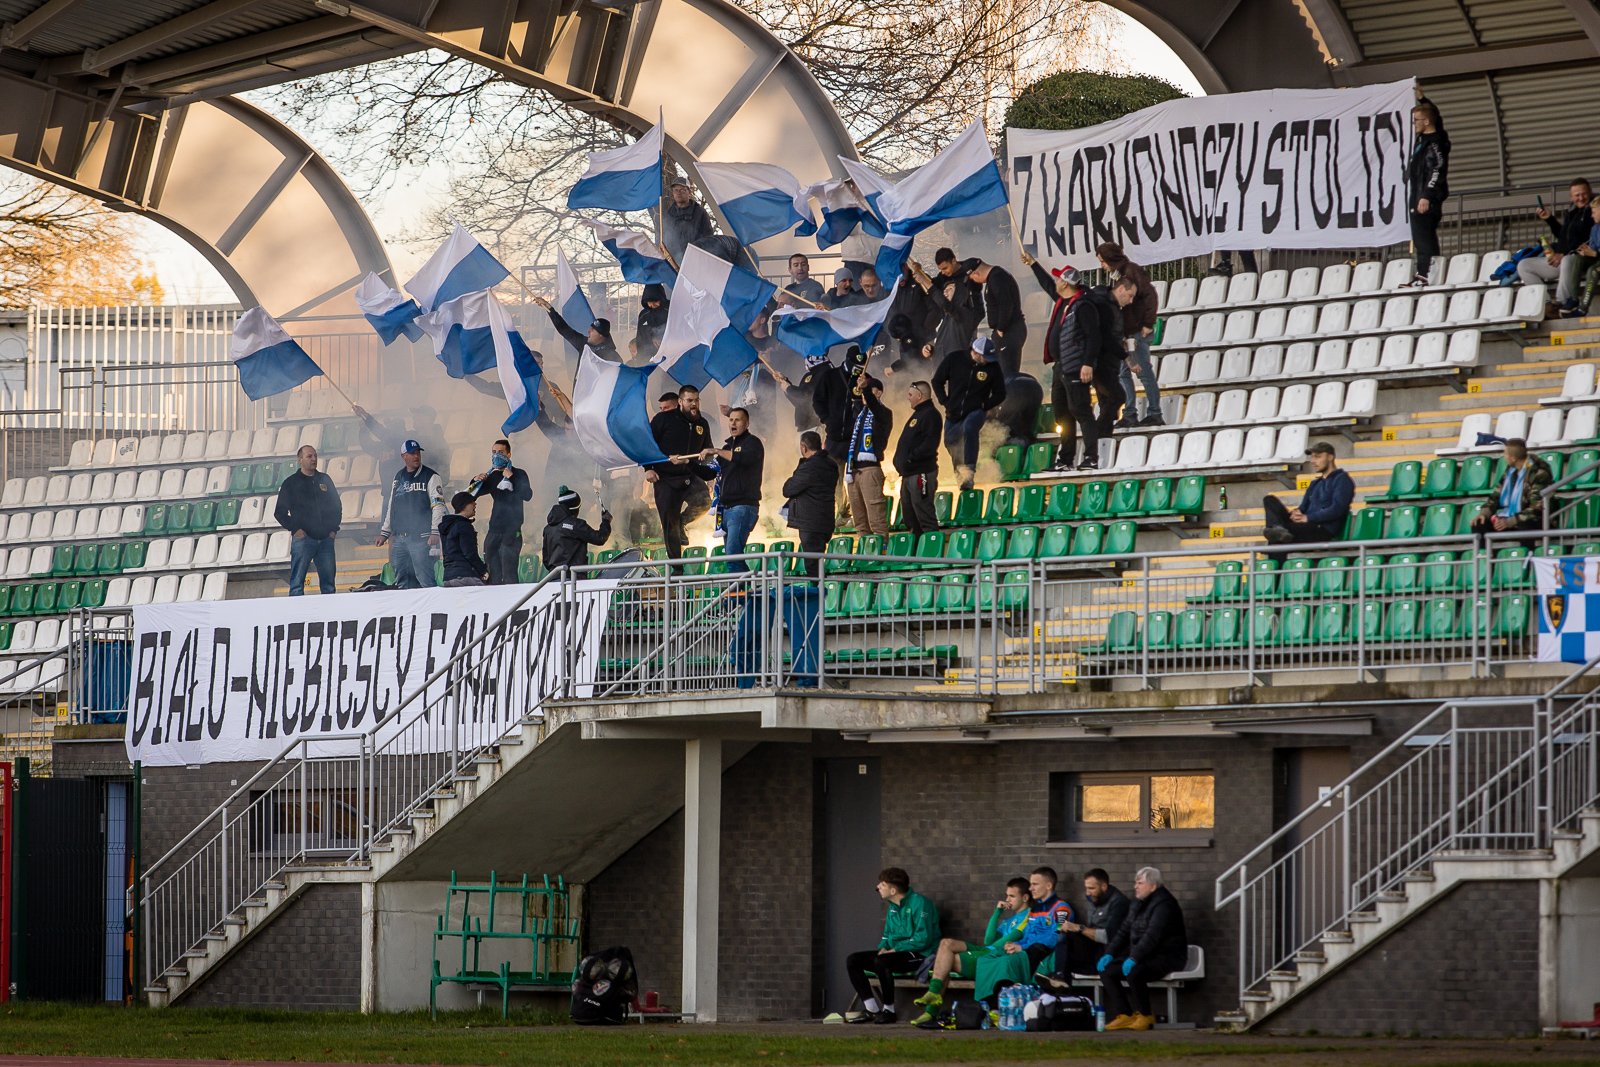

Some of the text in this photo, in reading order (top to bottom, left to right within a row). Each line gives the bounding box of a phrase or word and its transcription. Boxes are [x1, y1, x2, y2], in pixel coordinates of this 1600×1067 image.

[1013, 109, 1414, 259] Z KARKONOSZY STOLICY
[132, 598, 595, 747] BIAŁO-NIEBIESCY FANATYCY
